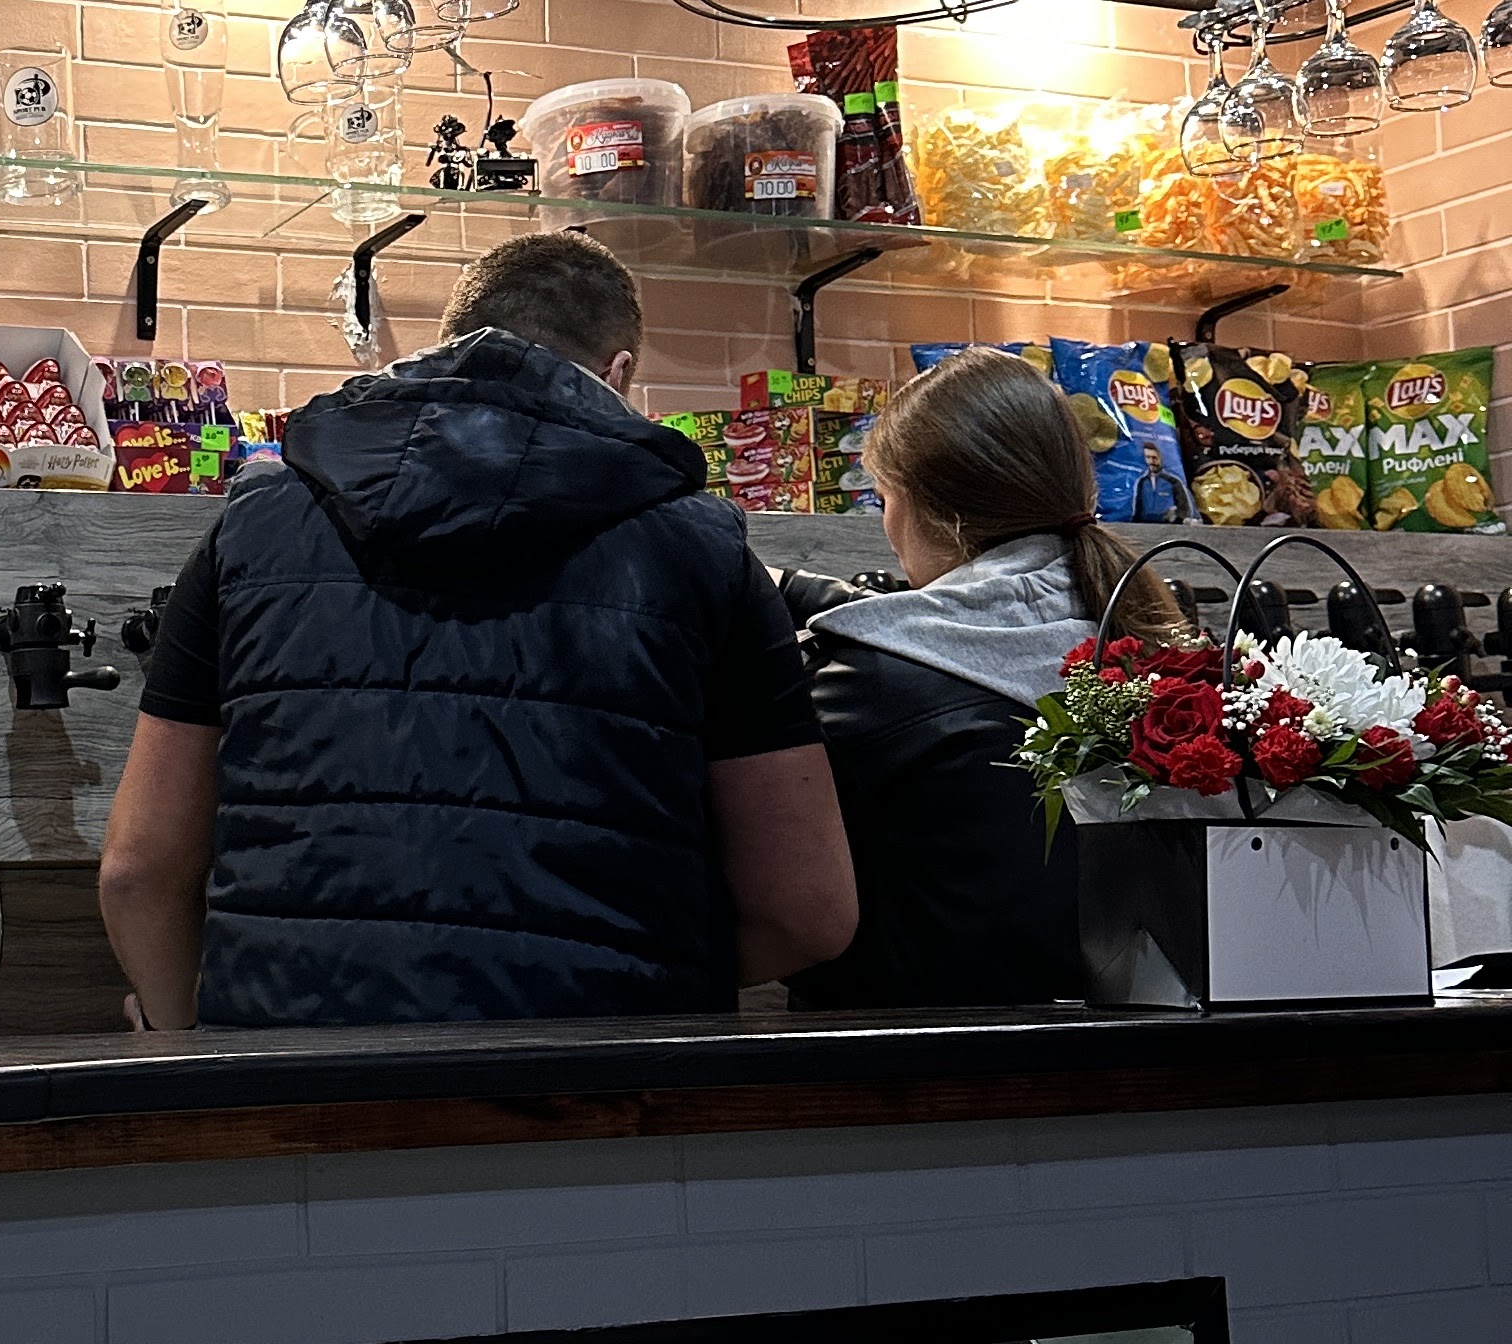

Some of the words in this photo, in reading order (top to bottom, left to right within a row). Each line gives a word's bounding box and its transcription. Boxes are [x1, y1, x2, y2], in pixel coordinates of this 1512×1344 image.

[1114, 379, 1157, 410] Lay's
[1392, 373, 1444, 407] Lay's
[1221, 391, 1276, 425] Lay's
[1299, 424, 1365, 458] AX
[1369, 413, 1479, 460] MAX
[118, 463, 163, 489] Love
[1302, 460, 1351, 477] флені
[1382, 447, 1465, 474] Рифлені
